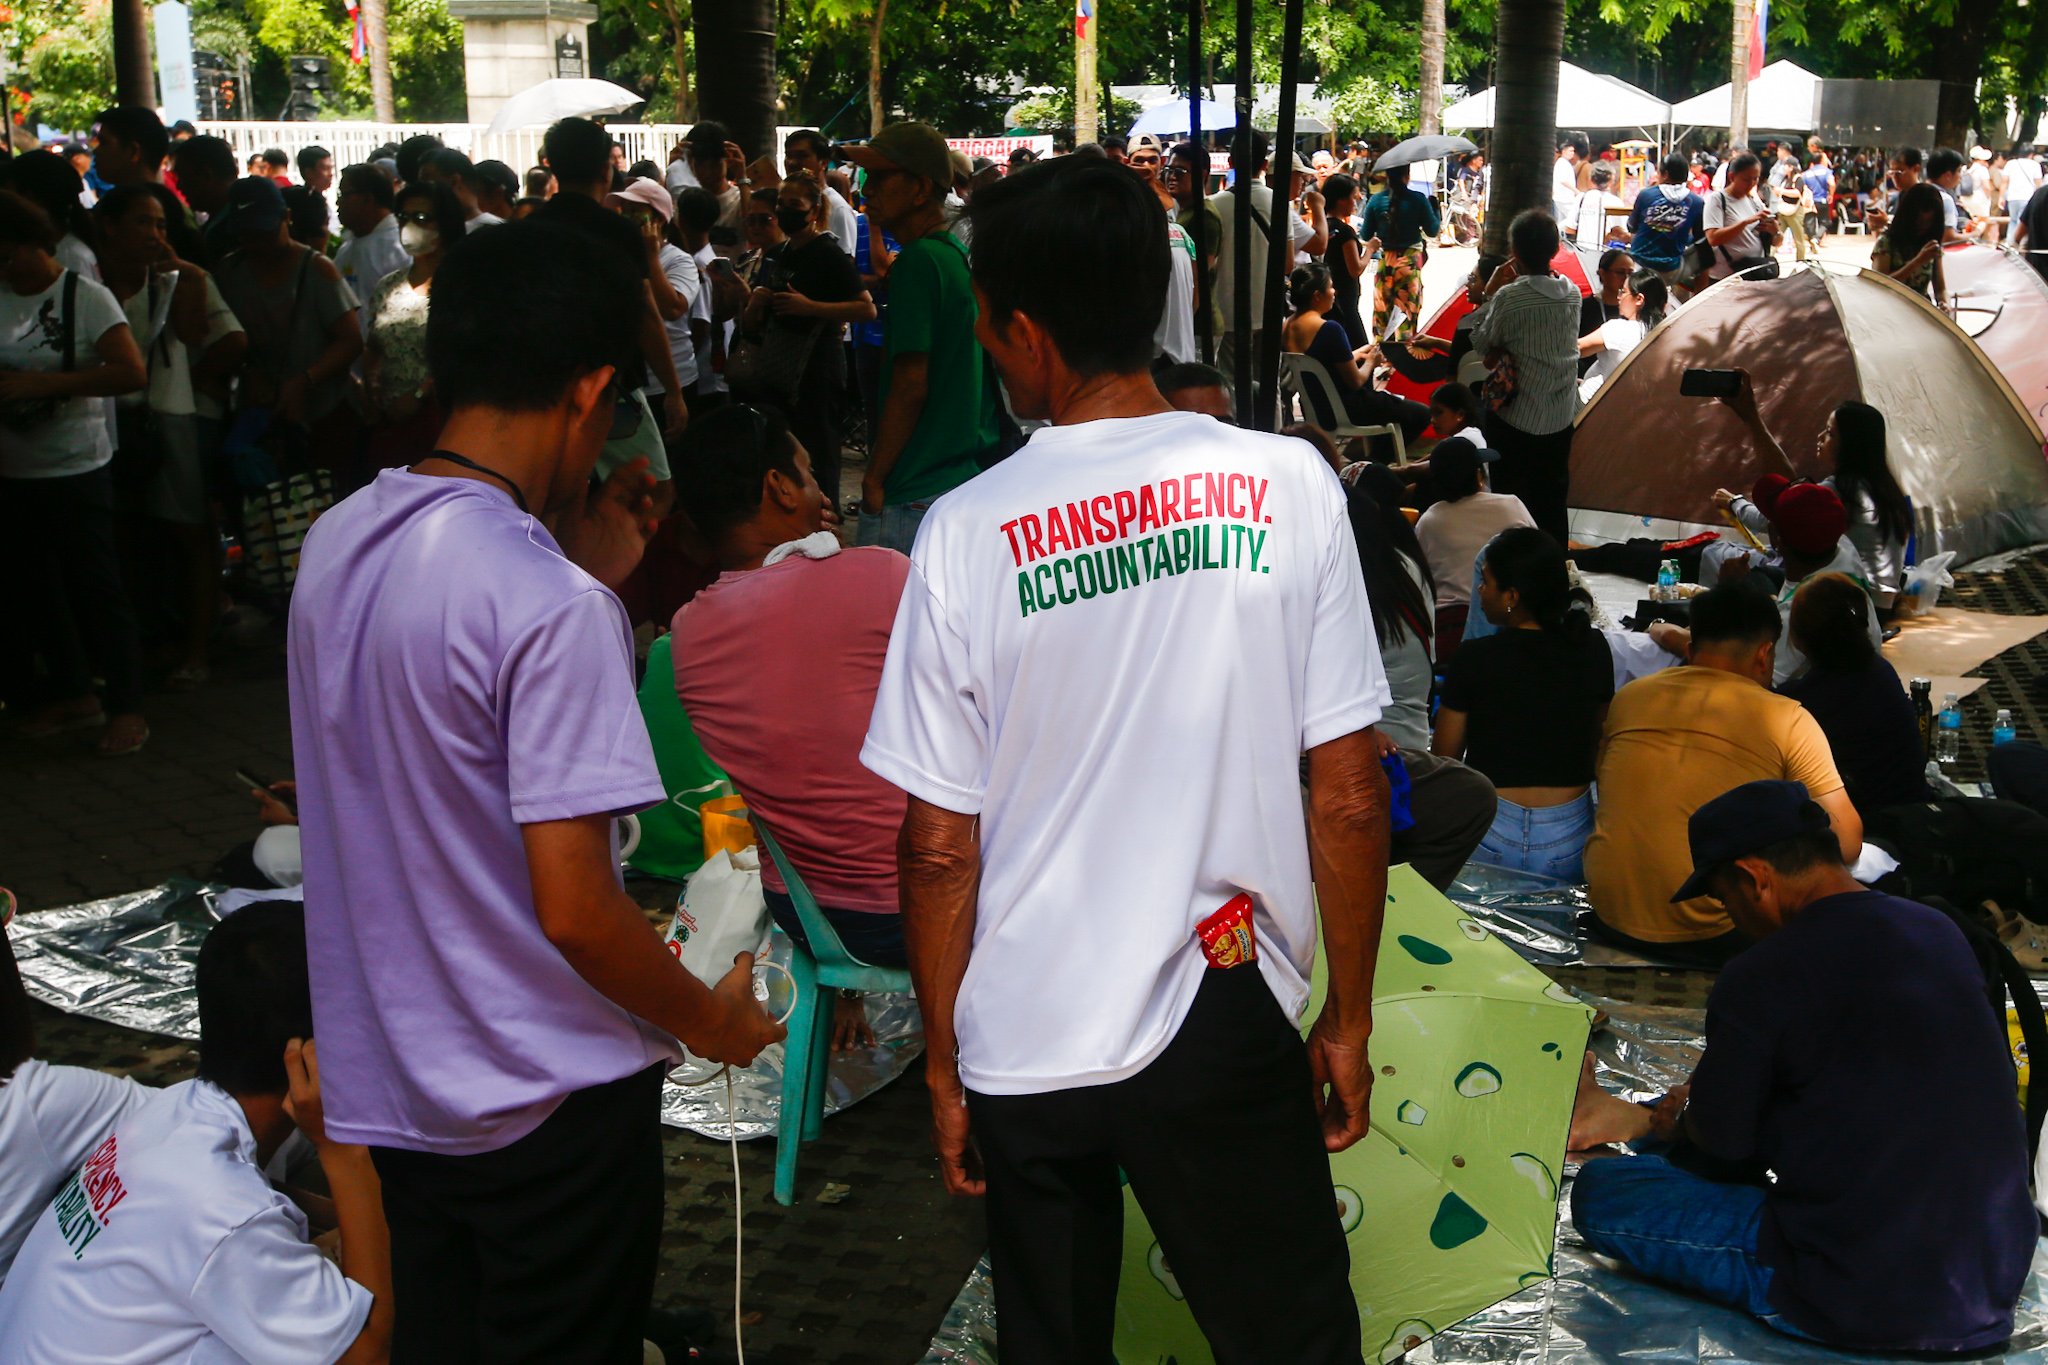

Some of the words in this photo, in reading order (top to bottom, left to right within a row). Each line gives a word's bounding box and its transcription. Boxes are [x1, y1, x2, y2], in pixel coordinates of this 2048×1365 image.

[1646, 205, 1690, 217] ESCAPE
[1000, 472, 1272, 567] TRANSPARENCY.
[1017, 523, 1270, 618] ACCOUNTABILITY.
